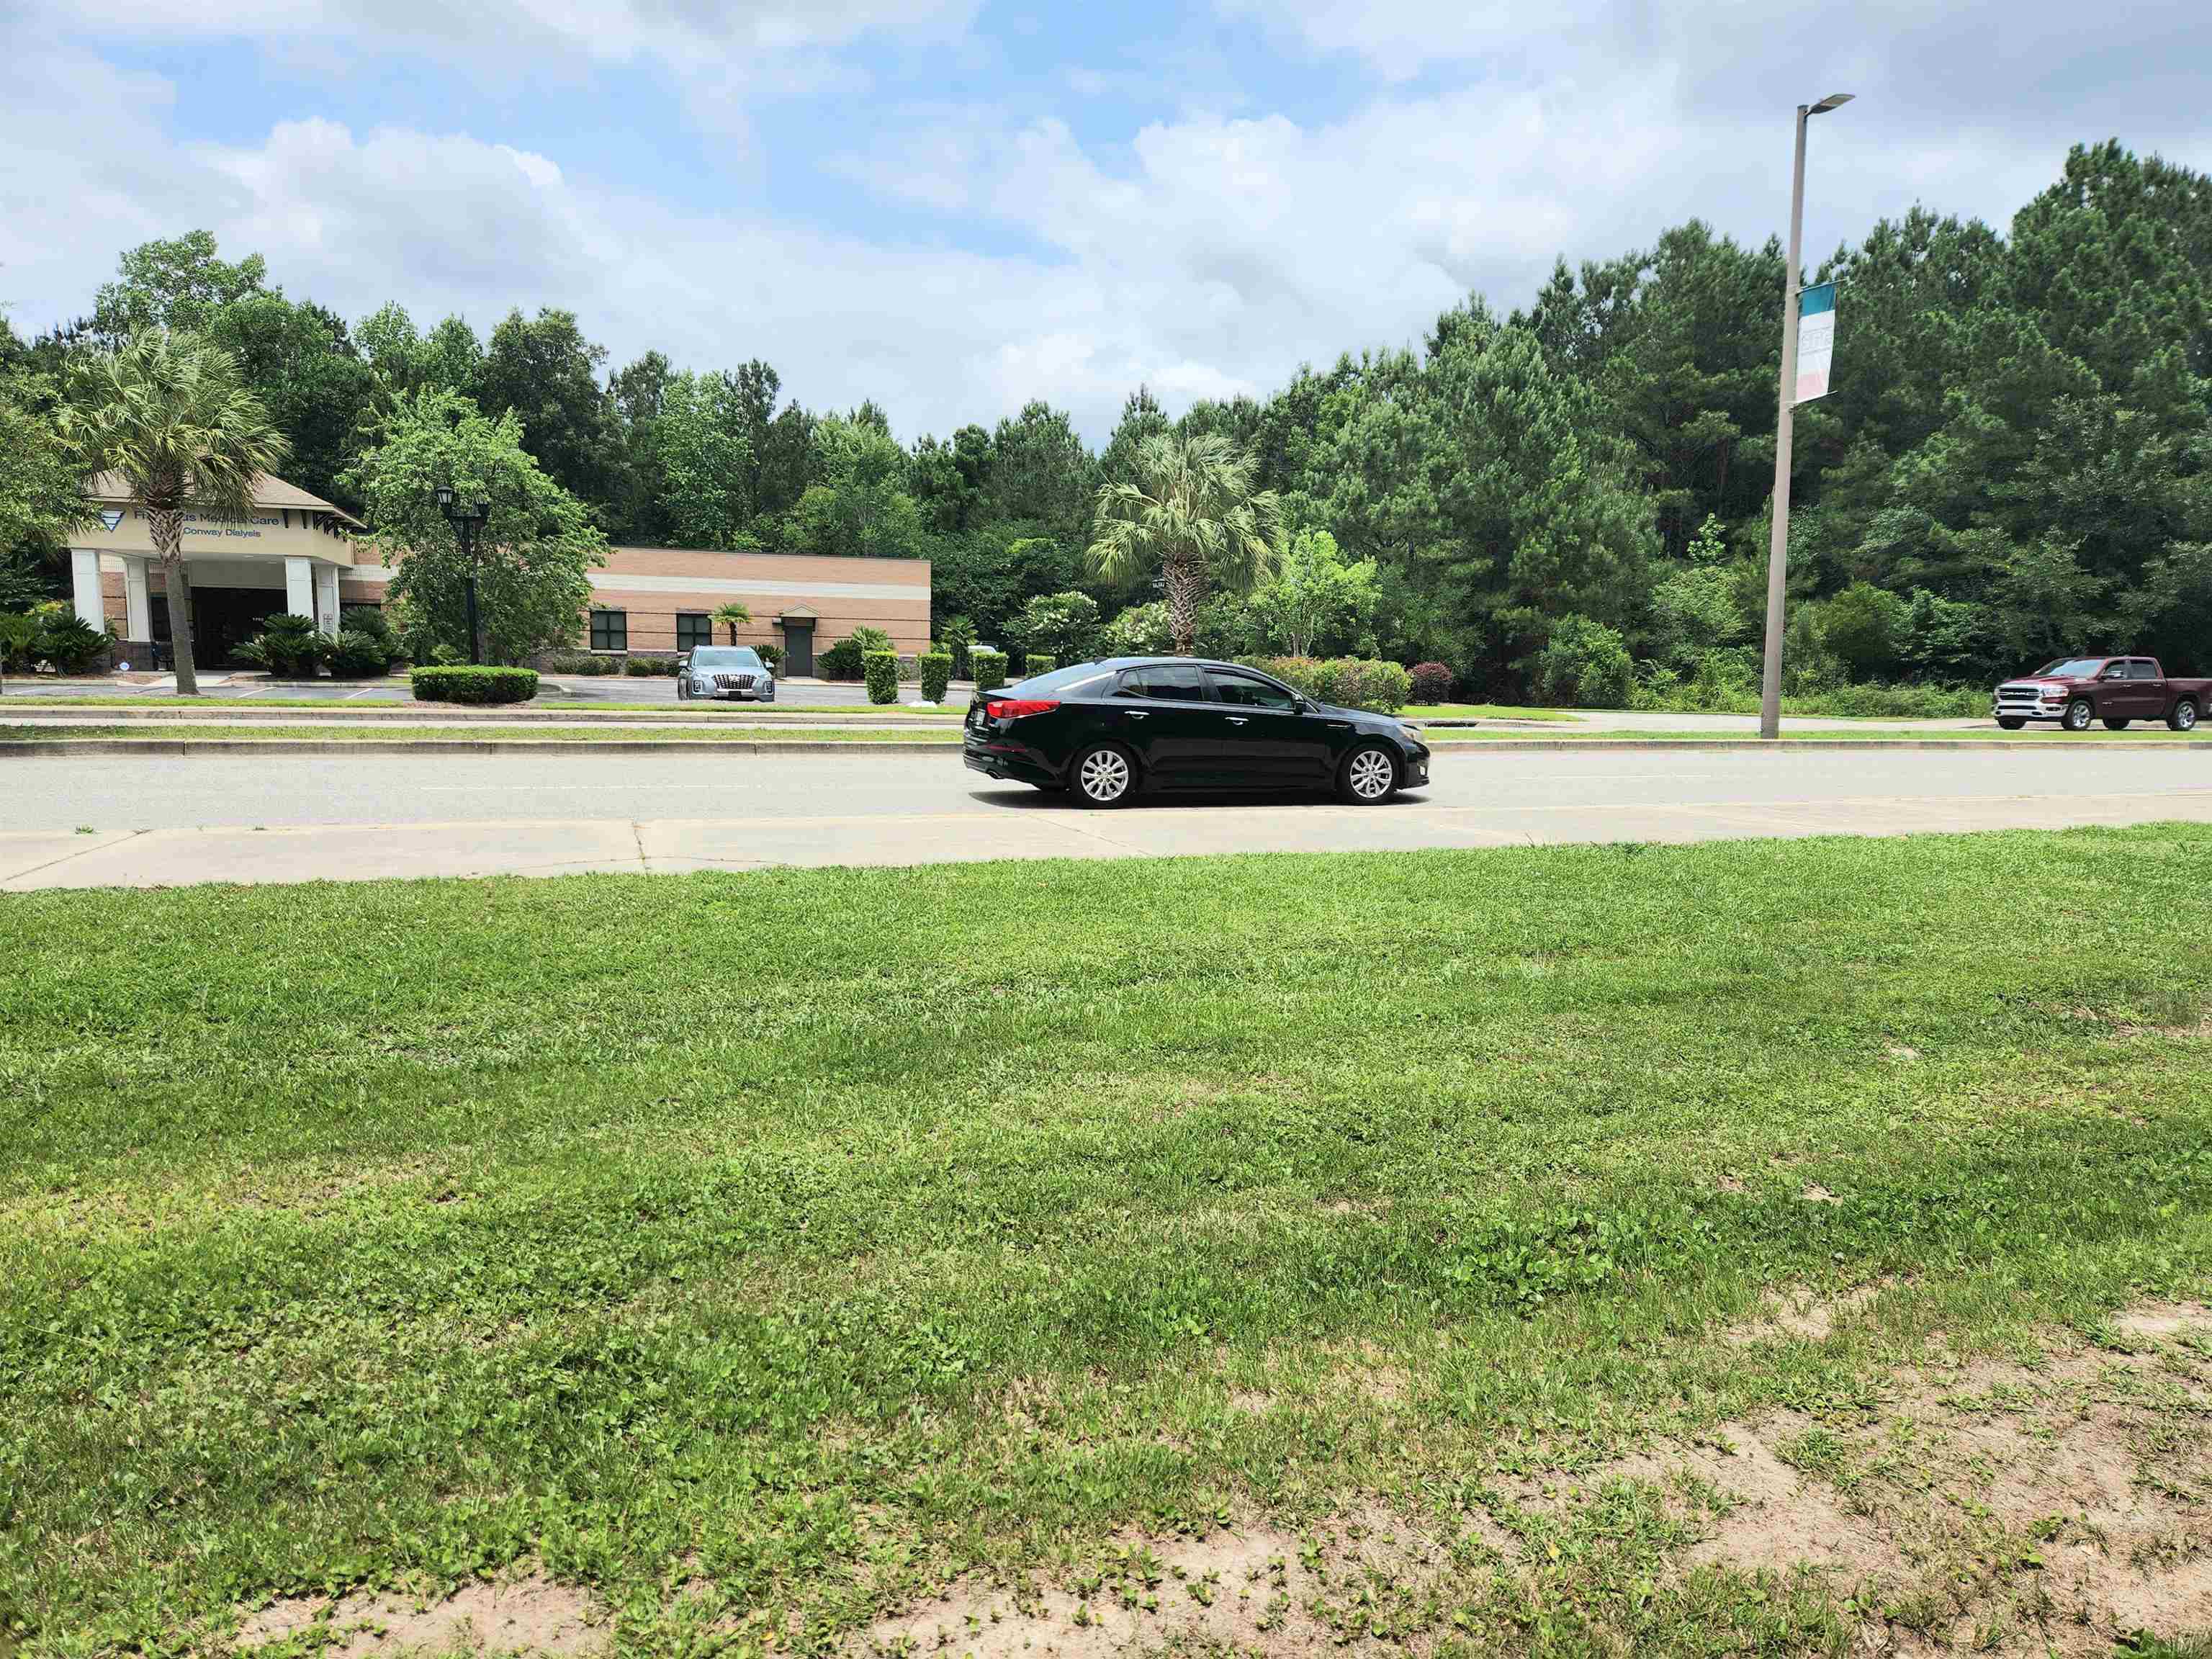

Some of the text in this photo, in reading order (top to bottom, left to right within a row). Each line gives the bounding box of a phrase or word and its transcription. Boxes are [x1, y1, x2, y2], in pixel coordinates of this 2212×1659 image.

[251, 516, 279, 526] Care
[183, 526, 261, 539] Conway Dialysis
